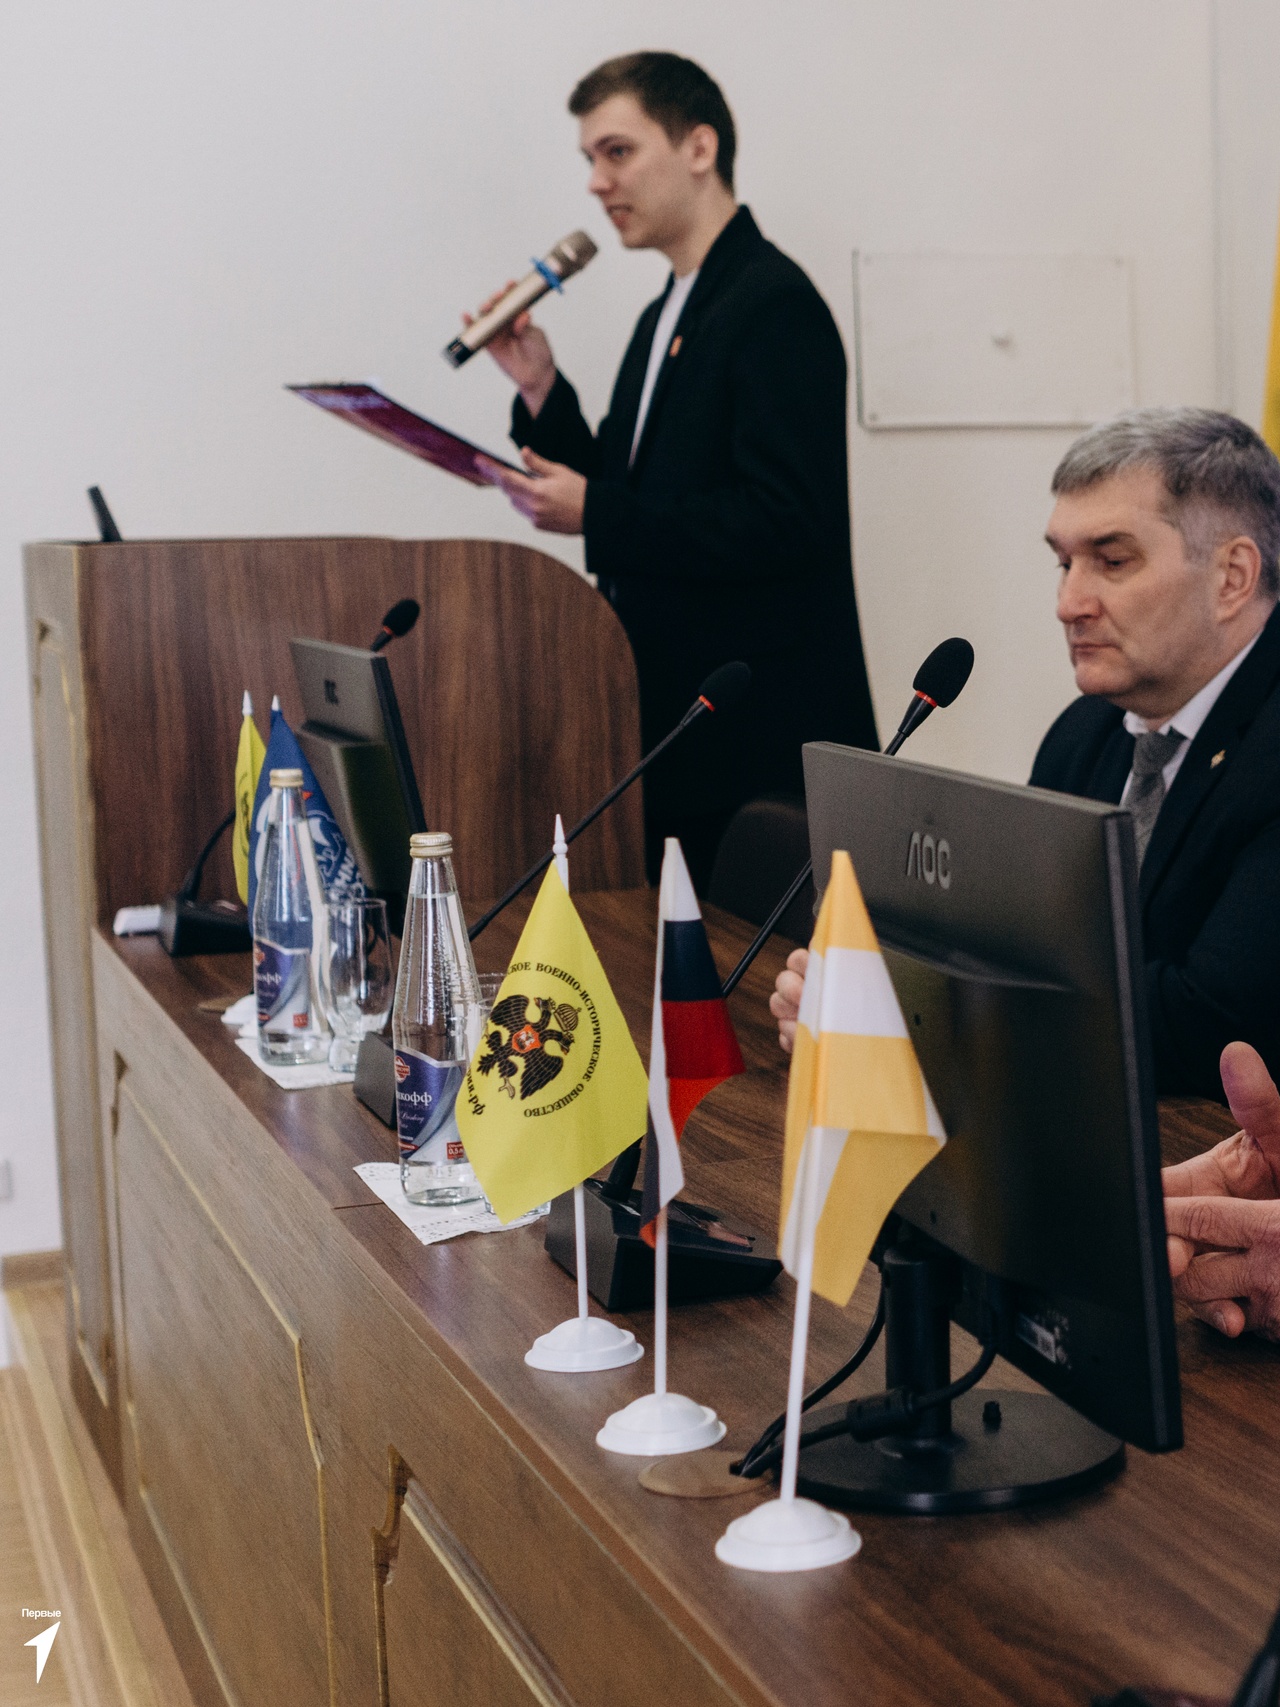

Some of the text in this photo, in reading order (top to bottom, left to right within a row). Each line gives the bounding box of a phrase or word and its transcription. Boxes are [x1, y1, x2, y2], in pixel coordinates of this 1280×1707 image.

[535, 962, 602, 1082] ВОЕННО-ИСТОРИЧЕСКОЕ
[397, 1091, 432, 1106] кофф
[523, 1083, 584, 1118] ОБЩЕСТВО
